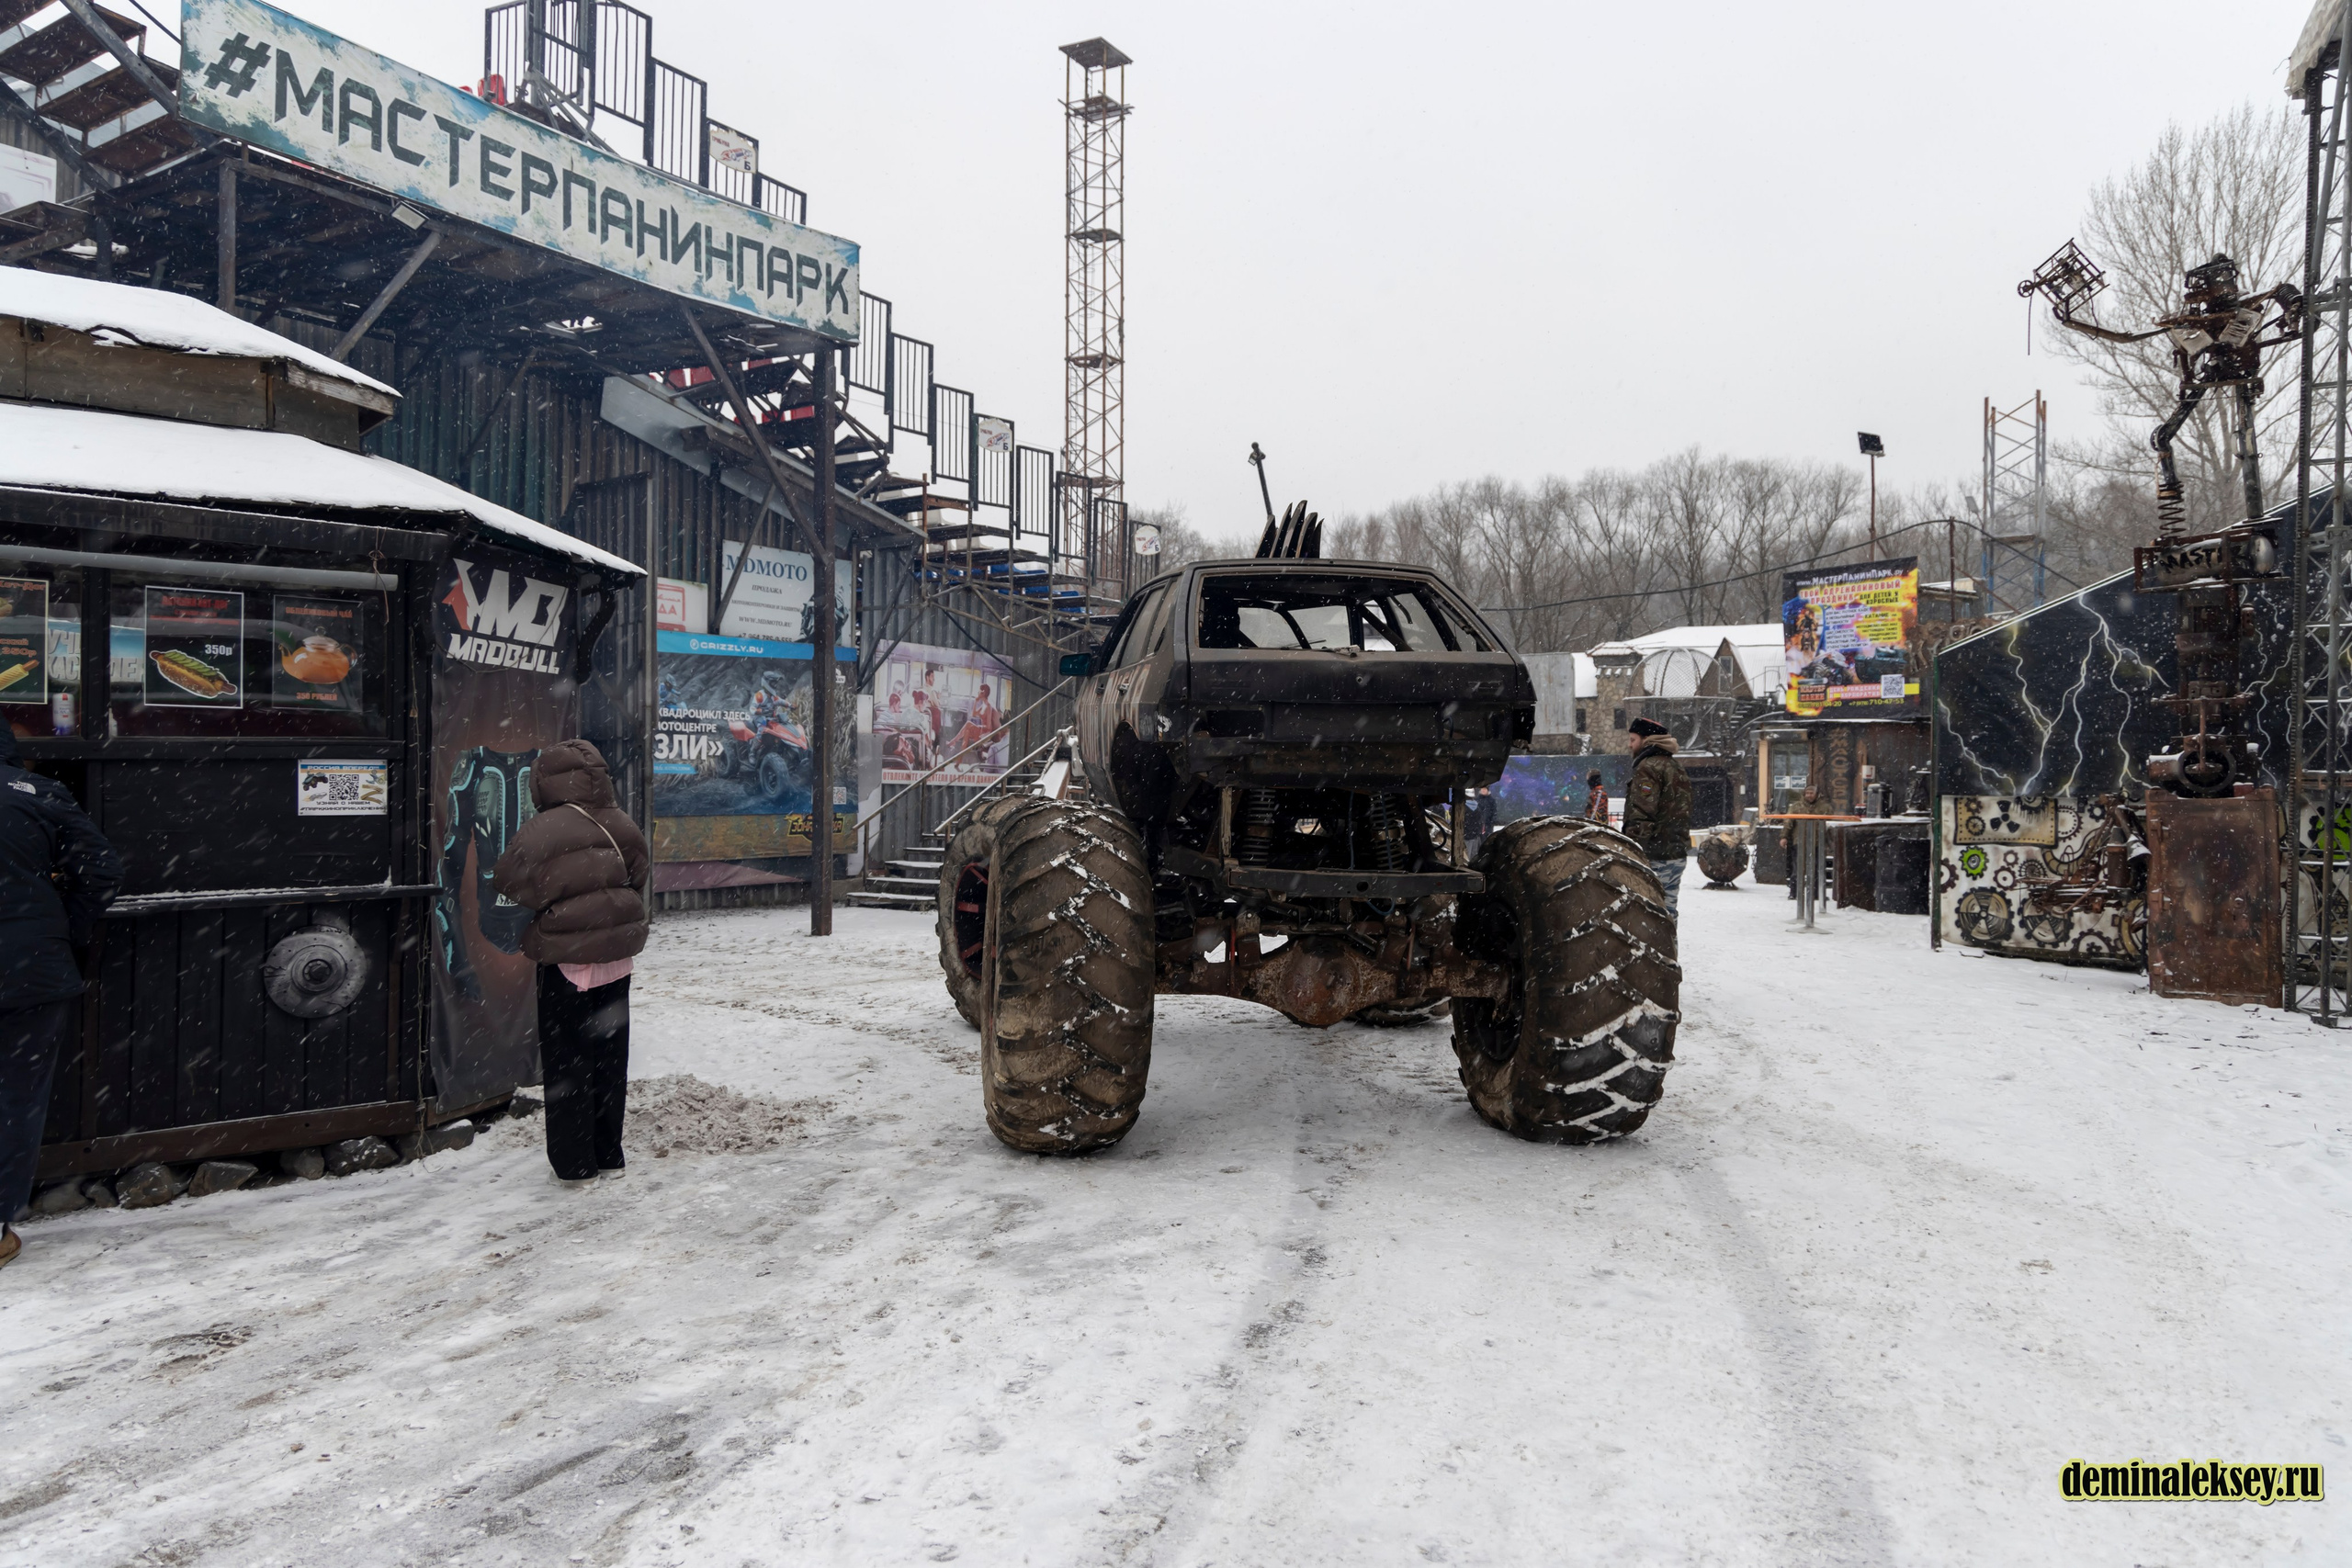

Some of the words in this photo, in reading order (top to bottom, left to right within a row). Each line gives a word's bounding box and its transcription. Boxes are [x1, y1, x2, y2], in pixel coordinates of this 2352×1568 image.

[204, 32, 851, 315] #МАСТЕРПАНИНПАРК
[726, 555, 808, 581] MDMOTO
[1800, 589, 1819, 599] ТВОЙ
[1824, 579, 1901, 595] АДРЕНАЛИНОВЫЙ
[1866, 596, 1899, 604] ВЗРОСЛЫХ
[1874, 592, 1892, 600] ДЕТЕЙ
[739, 616, 792, 627] WWW.MDMOTO.RU
[204, 643, 233, 656] 350р
[700, 638, 763, 654] GRIZZLY.RU
[296, 692, 311, 701] 350
[311, 693, 338, 702] РУБЛЕЙ
[723, 711, 751, 721] ЗДЕСЬ
[658, 721, 717, 733] ОТОЦЕНТРЕ
